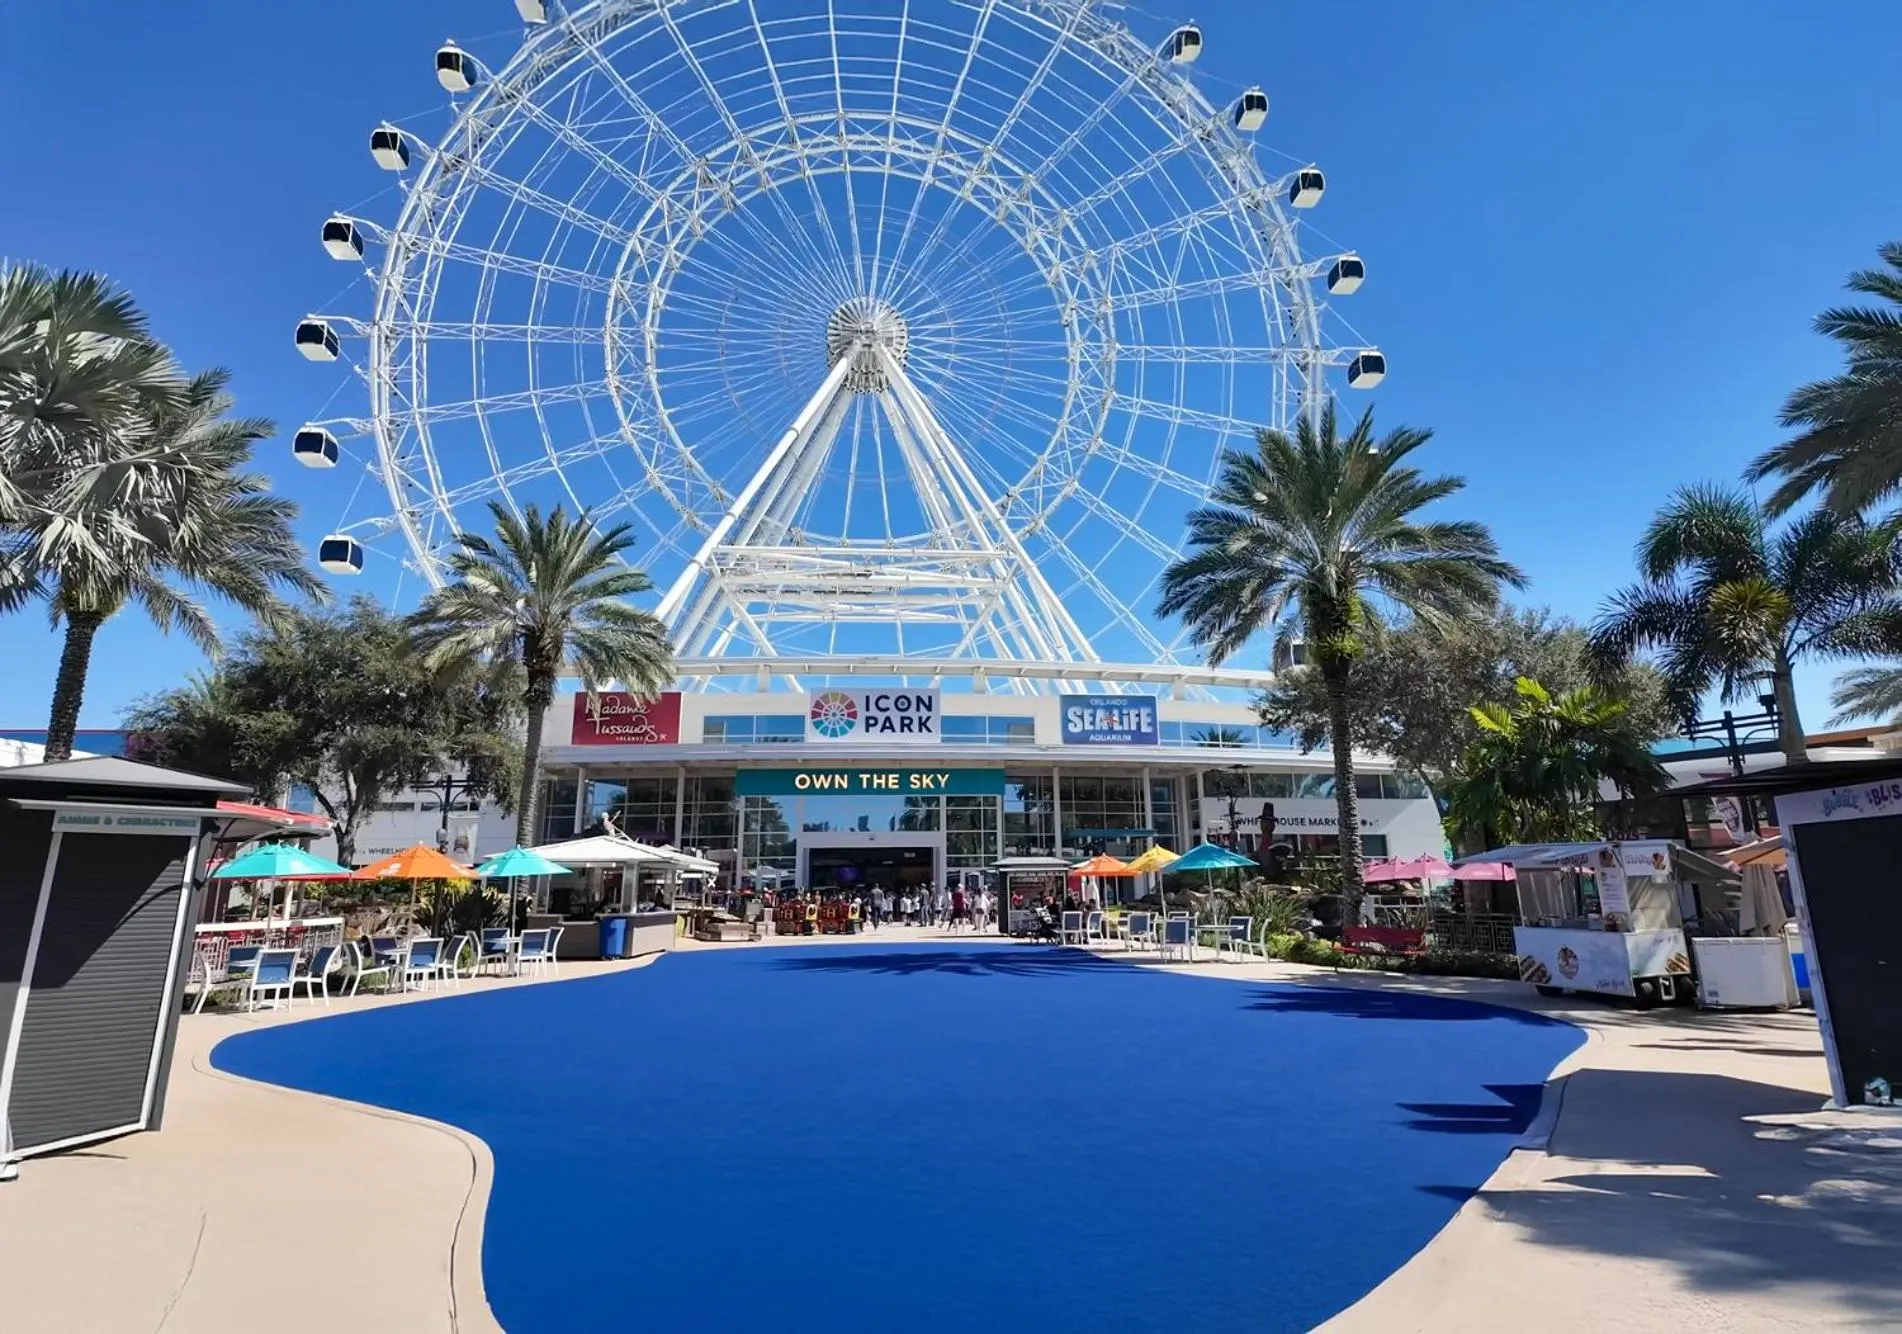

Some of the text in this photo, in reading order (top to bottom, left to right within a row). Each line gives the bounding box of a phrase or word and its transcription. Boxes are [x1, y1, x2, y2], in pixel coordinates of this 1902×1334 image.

[865, 695, 933, 712] ICON
[586, 714, 658, 742] Tussauds
[865, 716, 933, 733] PARK
[1067, 706, 1108, 733] SEA
[1089, 734, 1132, 742] AQUARIUM
[795, 773, 949, 789] OWN THE SKY
